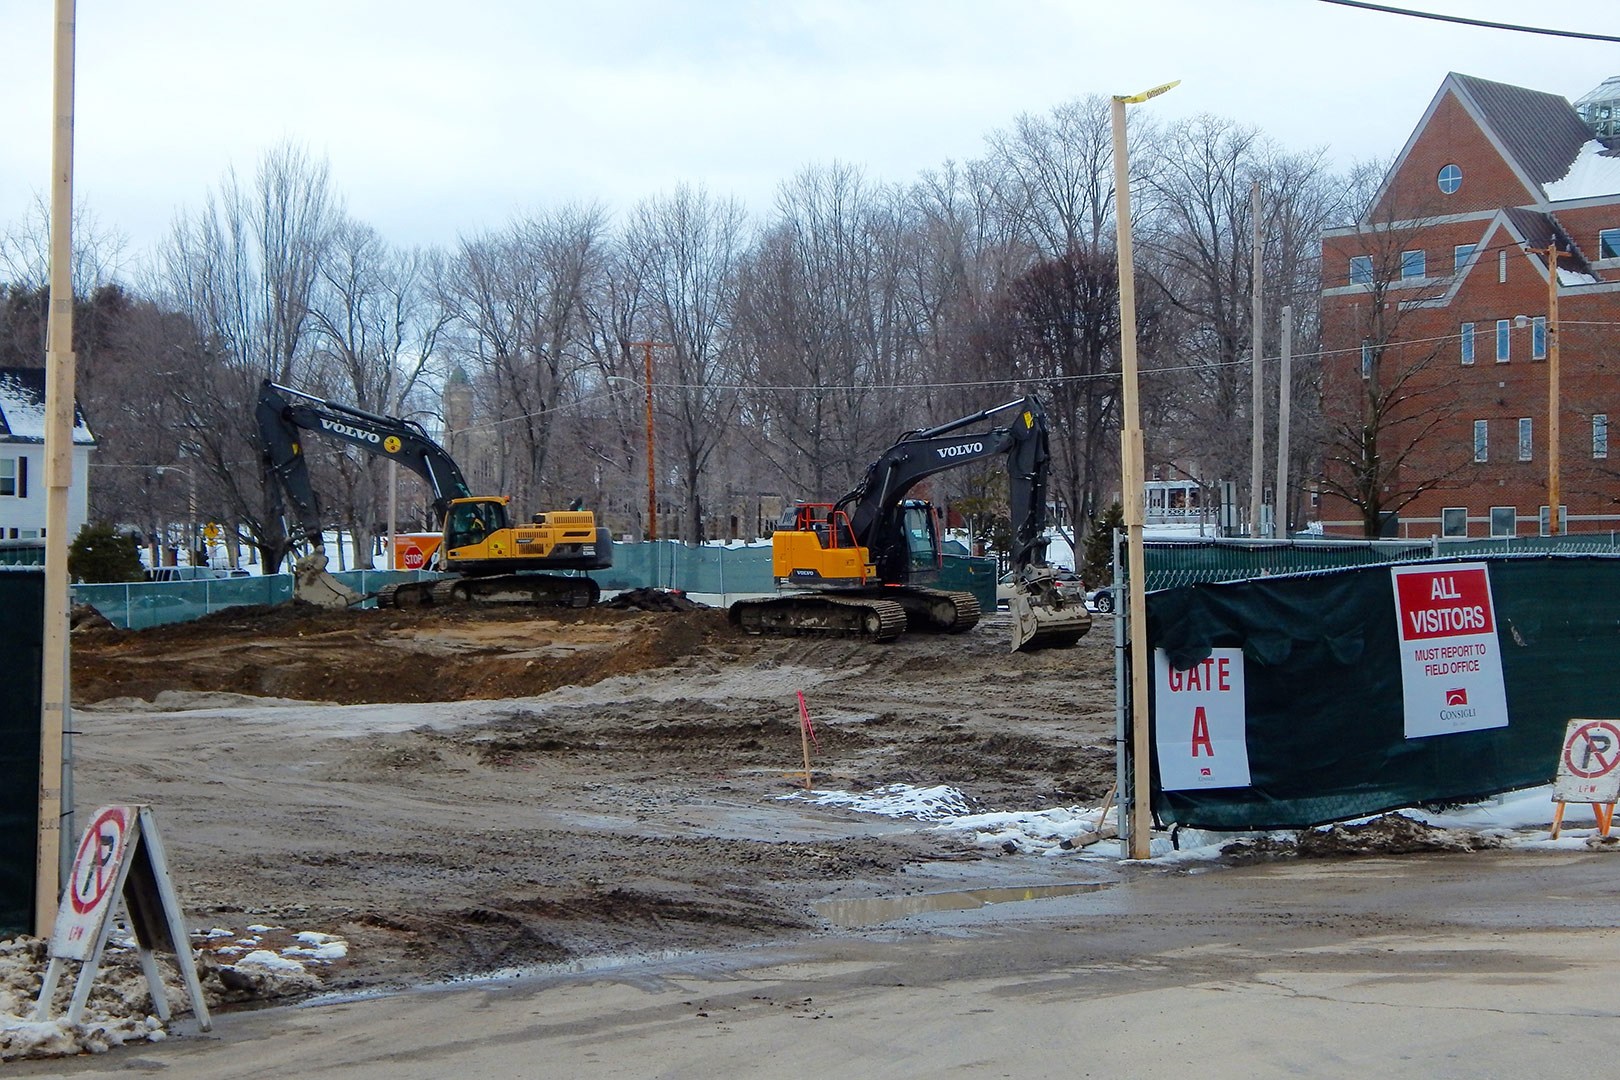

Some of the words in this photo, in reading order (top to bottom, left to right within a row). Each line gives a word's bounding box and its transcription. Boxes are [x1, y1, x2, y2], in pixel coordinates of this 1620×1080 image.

[320, 418, 380, 443] VOLVO
[937, 442, 983, 458] VOLVO
[405, 554, 423, 565] STOP
[1431, 576, 1461, 600] ALL
[1410, 605, 1485, 633] VISITORS
[1415, 648, 1439, 662] MUST
[1441, 644, 1474, 659] REPORT
[1475, 643, 1486, 656] TO
[1168, 658, 1231, 692] GATE
[1425, 663, 1449, 676] FIELD
[1450, 660, 1480, 674] OFFICE
[1440, 708, 1476, 721] CONSIGLI
[1191, 706, 1215, 757] A
